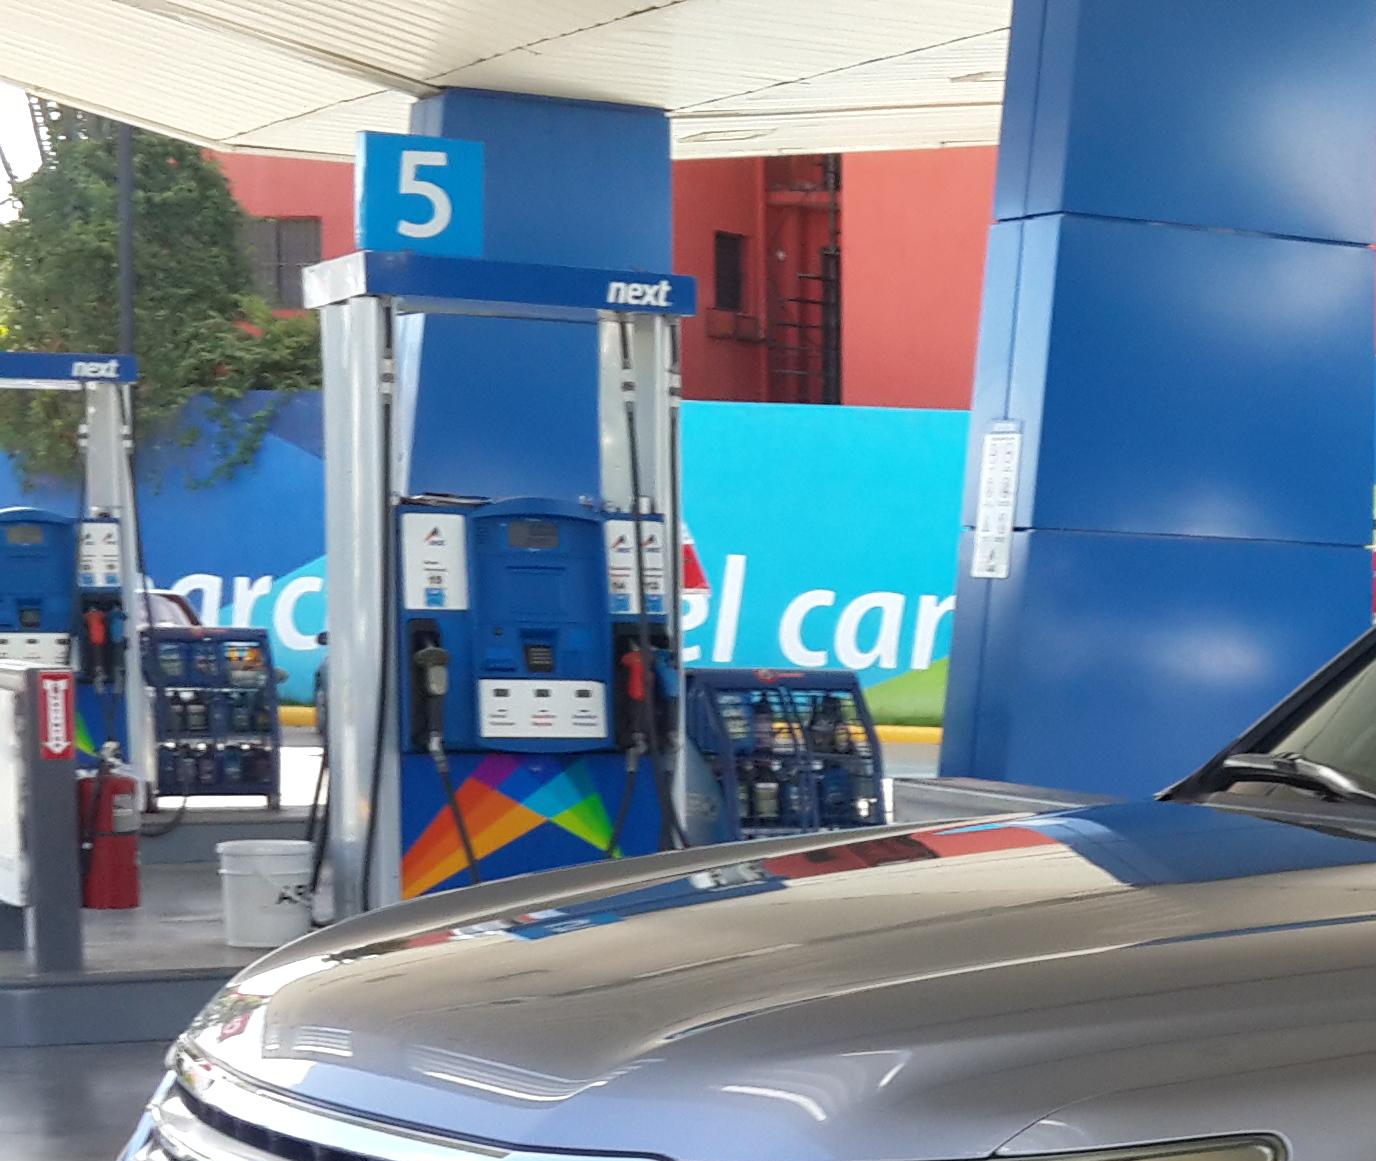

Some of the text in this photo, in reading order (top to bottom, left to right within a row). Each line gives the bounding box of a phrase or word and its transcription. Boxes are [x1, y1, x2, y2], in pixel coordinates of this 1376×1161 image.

[397, 150, 453, 240] 5
[606, 280, 673, 307] next
[71, 358, 120, 379] next
